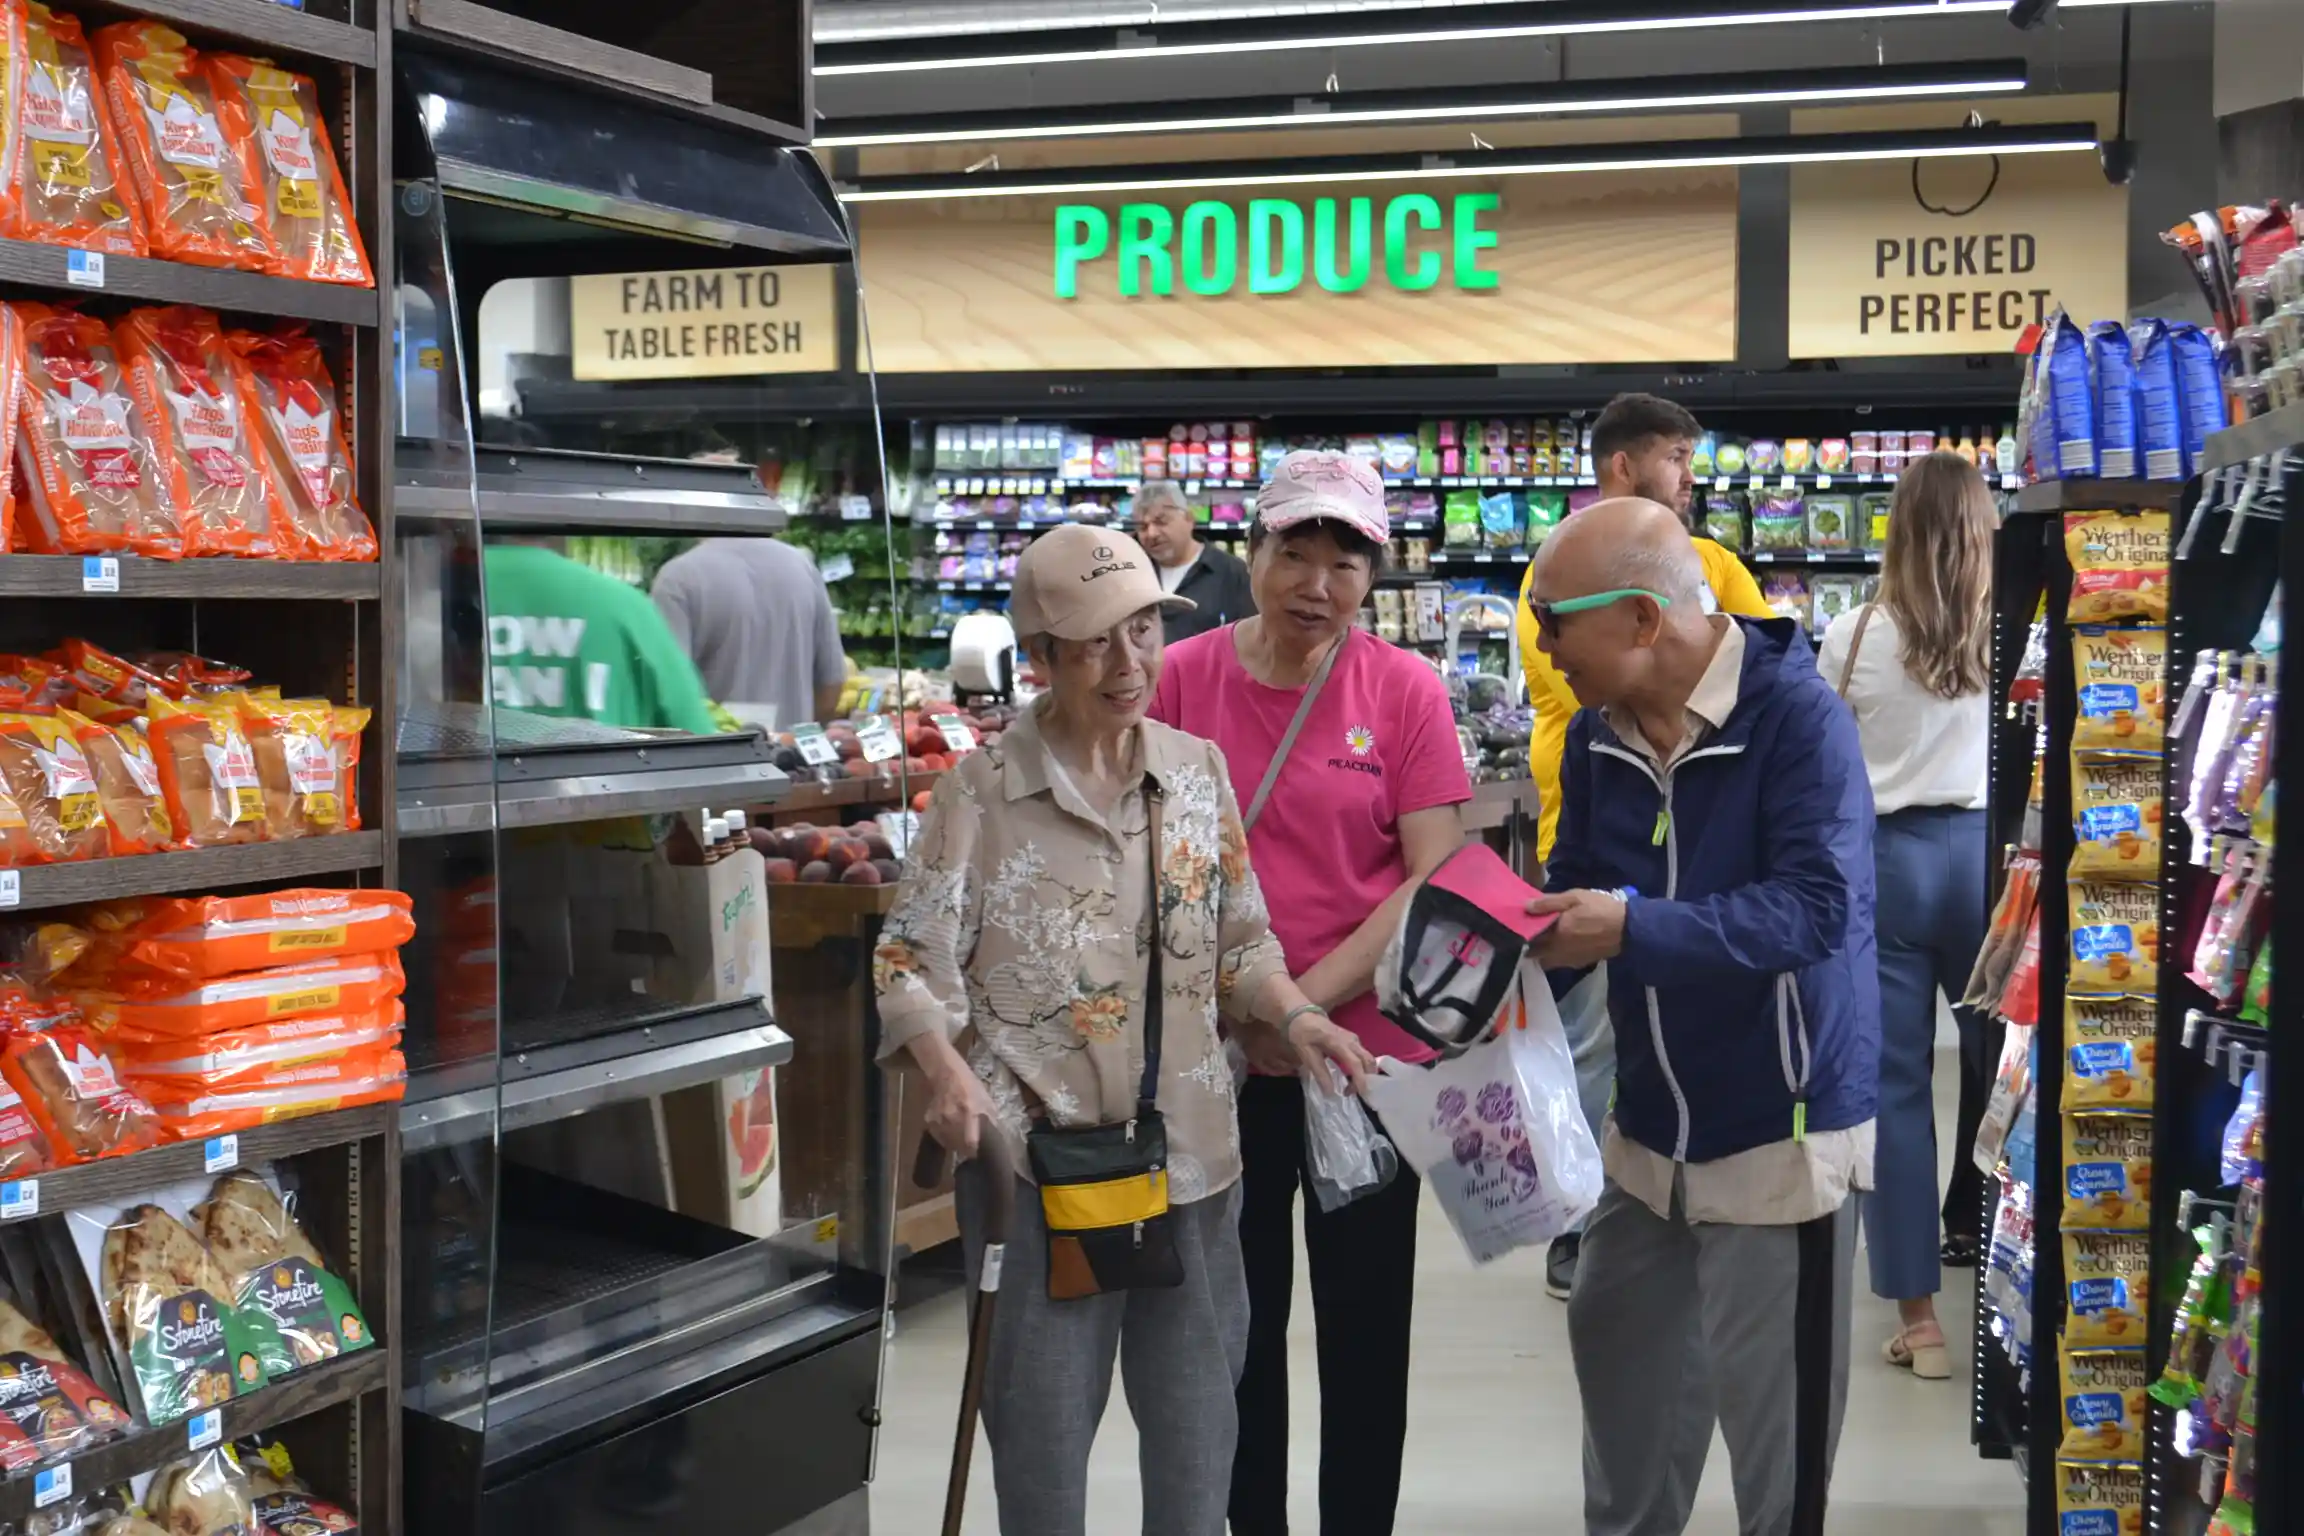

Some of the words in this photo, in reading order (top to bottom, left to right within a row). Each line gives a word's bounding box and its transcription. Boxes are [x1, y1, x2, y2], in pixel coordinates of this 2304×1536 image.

[1054, 193, 1499, 299] PRODUCE
[1876, 234, 2036, 279] PICKED
[621, 274, 722, 314] FARM
[735, 271, 780, 309] TO
[1860, 289, 2052, 335] PERFECT
[604, 326, 696, 361] TABLE
[704, 321, 802, 357] FRESH
[1080, 561, 1137, 582] LEXUS
[256, 1268, 324, 1312] Stonefire
[161, 1303, 224, 1351] Stonefire
